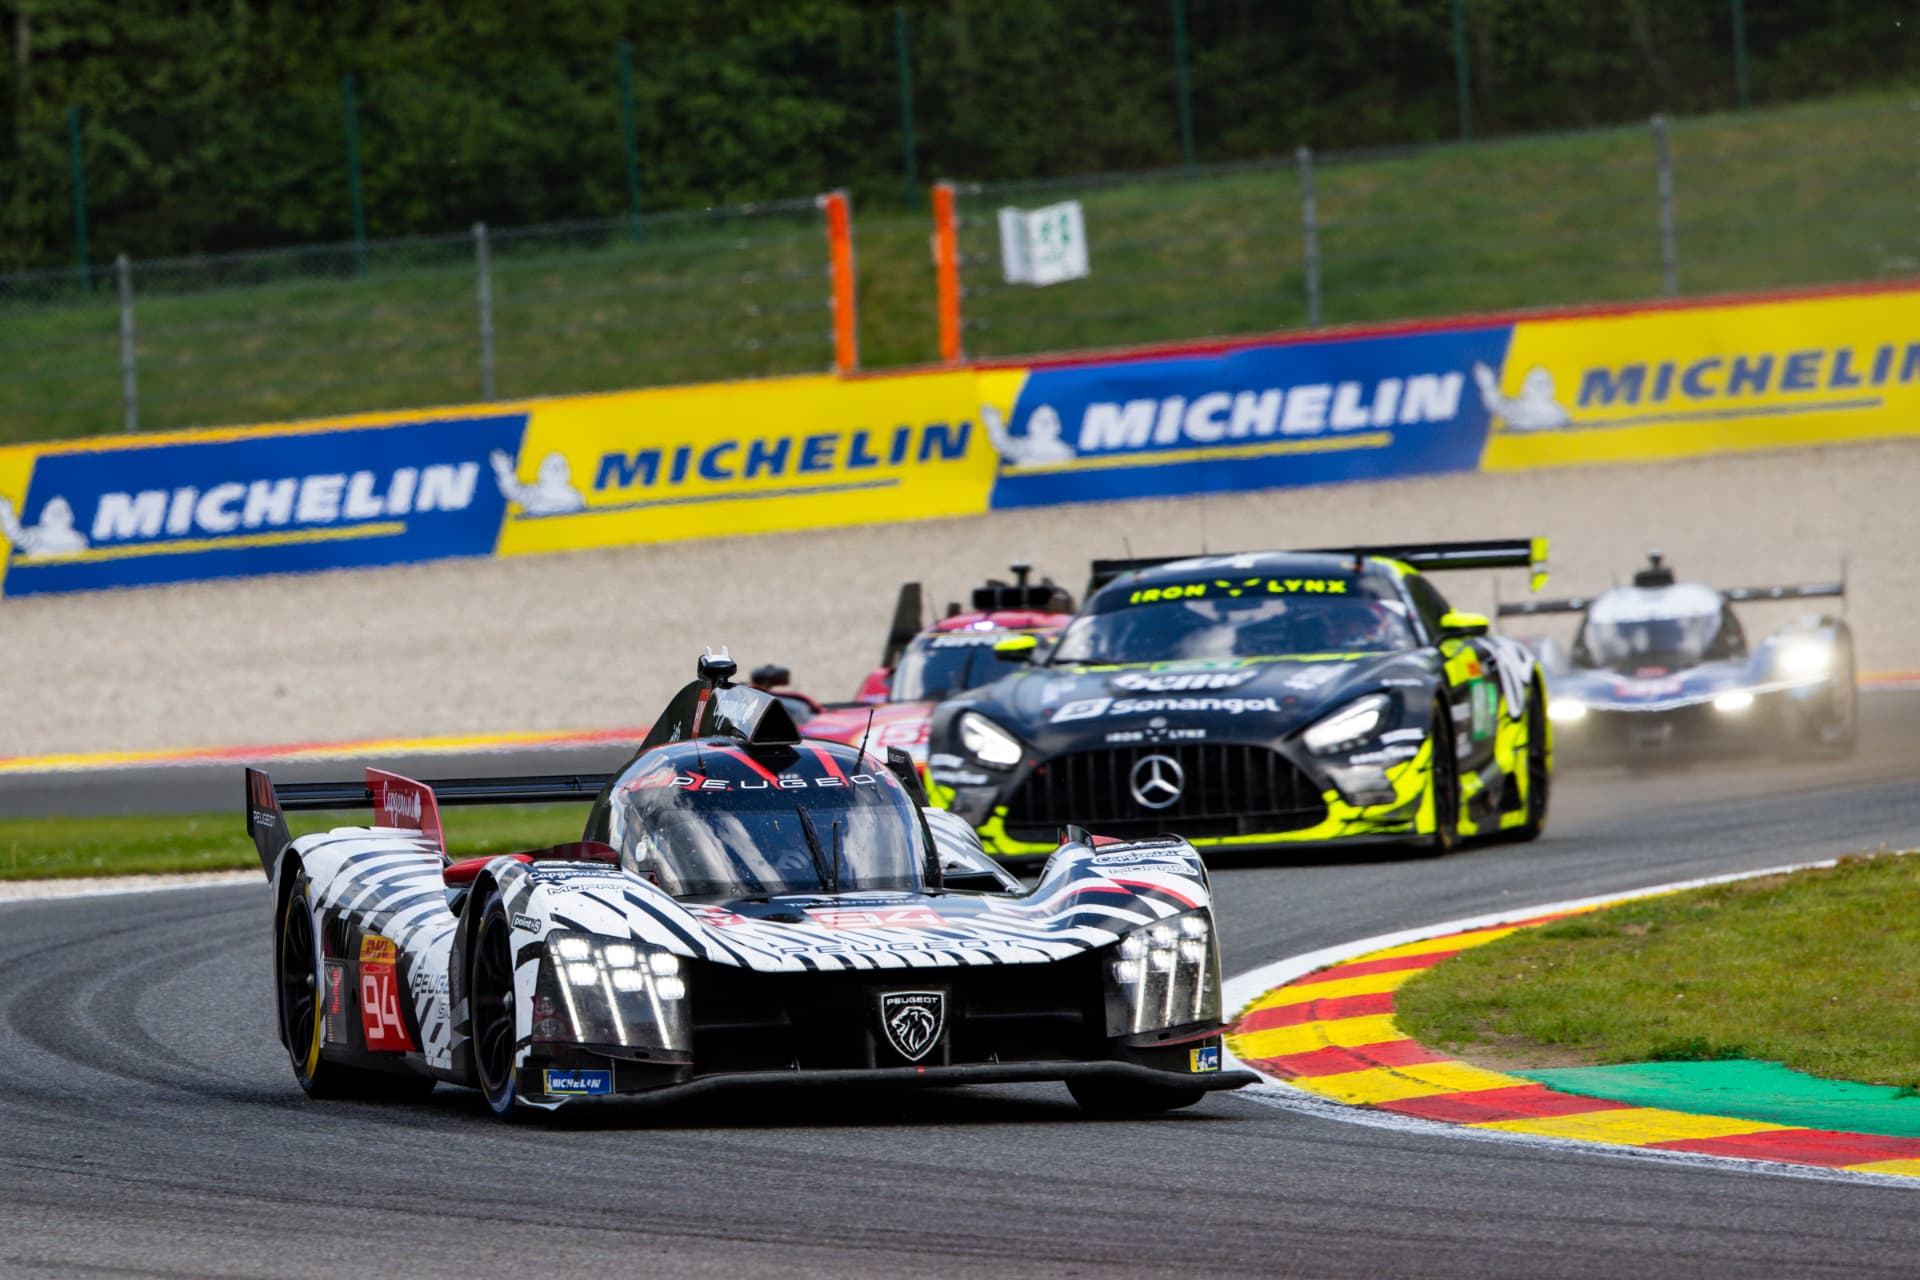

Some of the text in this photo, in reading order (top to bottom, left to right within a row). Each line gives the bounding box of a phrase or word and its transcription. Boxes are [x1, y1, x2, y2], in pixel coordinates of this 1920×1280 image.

[1079, 372, 1465, 452] MICHELIN
[592, 420, 974, 491] MICHELIN
[92, 461, 479, 542] MICHELIN
[1129, 579, 1348, 604] IRON LYNX
[1108, 697, 1280, 715] Sonangol
[669, 769, 889, 790] PEUGEOT
[383, 780, 415, 827] Capgemini
[529, 869, 609, 880] Capgemini
[780, 939, 1021, 955] PEUGEOT
[363, 975, 406, 1040] 94
[886, 996, 938, 1005] PEUGEOT
[552, 1078, 602, 1089] MICHELIN
